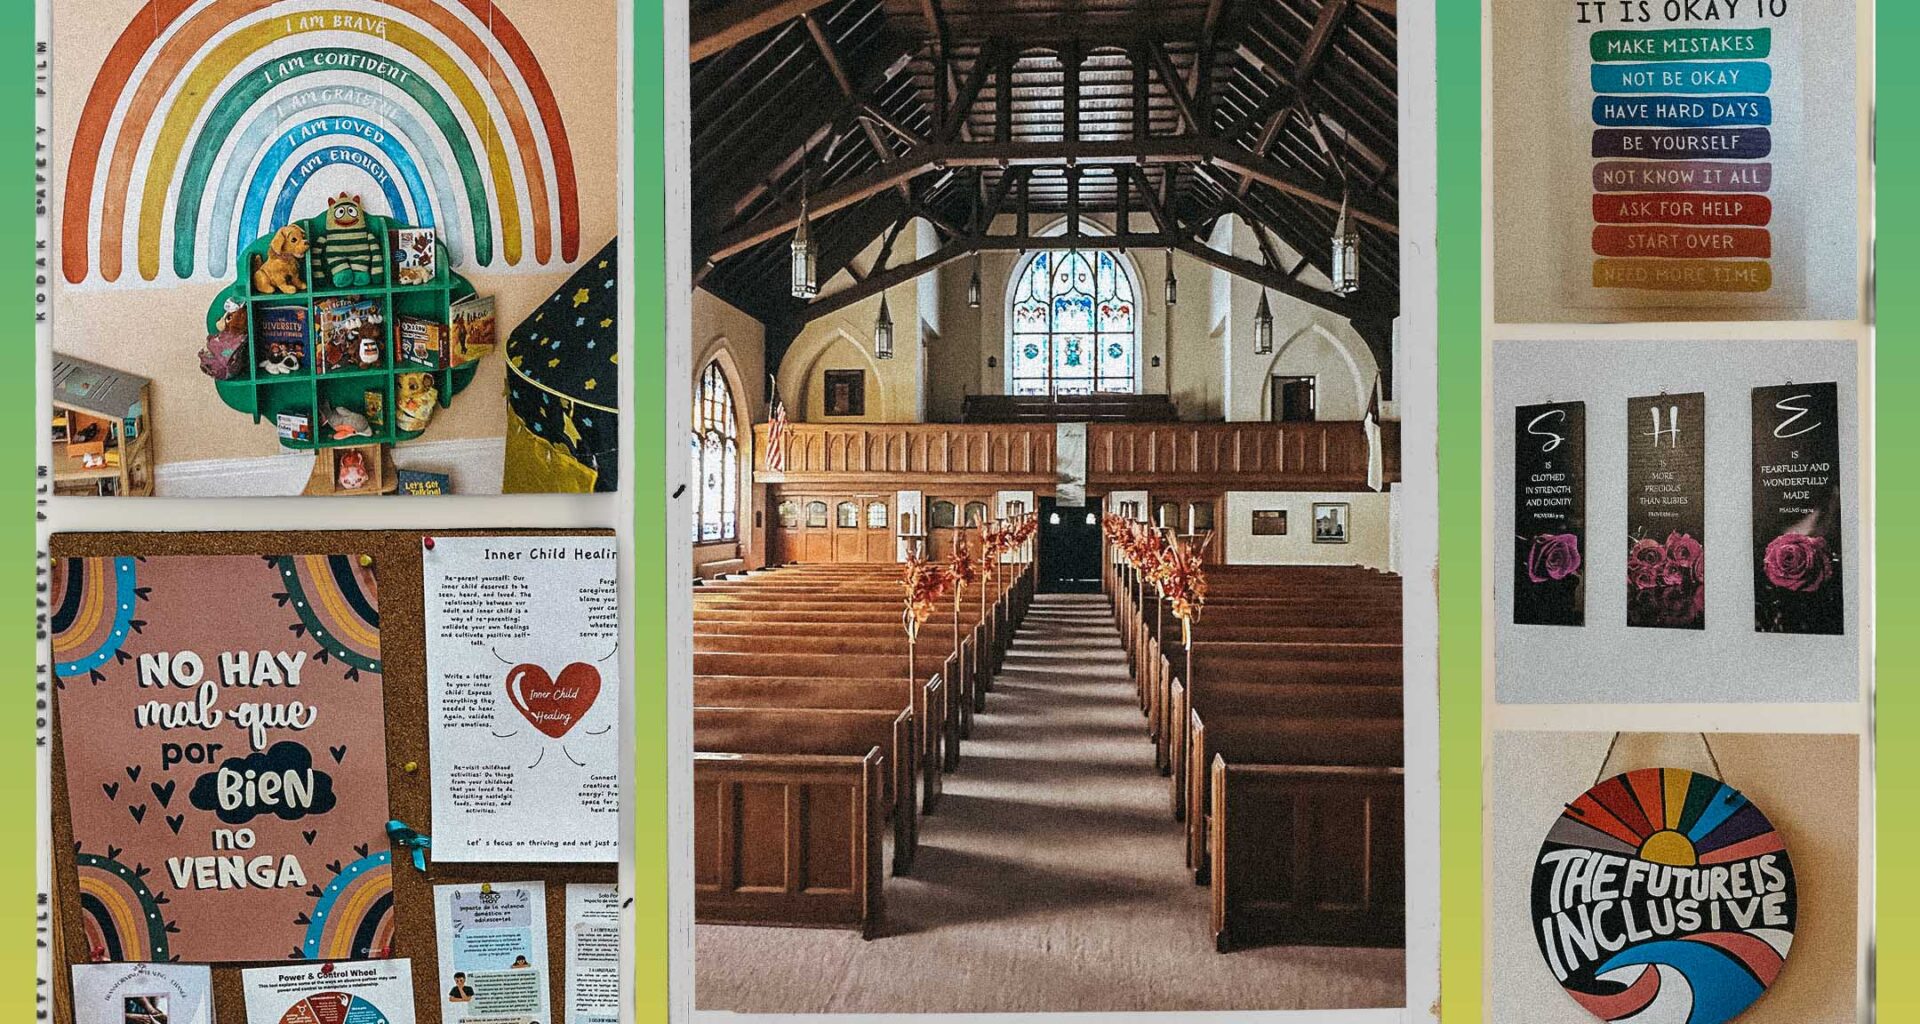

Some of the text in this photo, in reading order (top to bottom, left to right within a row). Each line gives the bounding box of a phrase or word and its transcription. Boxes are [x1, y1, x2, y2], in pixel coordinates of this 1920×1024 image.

[1578, 1, 1605, 24] IT
[1620, 1, 1651, 23] IS
[1664, 0, 1740, 22] OKAY
[287, 15, 387, 34] I AM BRAVE
[1608, 36, 1756, 54] MAKE MISTAKES
[264, 53, 410, 84] I AM CONFIDENT
[1622, 69, 1741, 87] NOT BE OKAY
[292, 91, 317, 106] AM
[1604, 102, 1759, 119] HAVE HARD DAYS
[287, 119, 385, 147] I AM LOVED
[1623, 135, 1741, 151] BE YOURSELF
[290, 150, 388, 187] I AM ENOUGH
[1603, 168, 1761, 184] NOT KNOW IT ALL
[1619, 201, 1743, 217] ASK FOR HELP
[1627, 234, 1734, 250] START OVER
[1604, 267, 1648, 283] NEED
[1712, 267, 1758, 283] TIME
[1774, 395, 1821, 438] E
[1528, 410, 1566, 452] S
[1643, 406, 1680, 448] H
[1792, 451, 1799, 459] IS
[1545, 461, 1552, 469] IS
[1761, 463, 1830, 473] FEARFULLY AND
[1532, 474, 1565, 482] CLOTHED
[1652, 472, 1673, 480] MORE
[1763, 477, 1829, 487] WONDERFULLY
[1535, 486, 1571, 494] STRENGTH
[1644, 485, 1681, 493] PRECIOUS
[1784, 491, 1810, 499] MADE
[1544, 498, 1572, 506] DIGNITY
[485, 548, 522, 560] Inner
[529, 548, 566, 560] Child
[138, 650, 307, 687] NO HAY
[529, 688, 578, 701] Inner Child
[135, 680, 317, 750] mal que
[532, 711, 573, 726] Healing
[162, 742, 223, 771] por
[213, 827, 256, 850] no
[529, 839, 559, 848] thriving
[165, 854, 307, 890] VENGA
[1541, 849, 1786, 914] THE FUTURE IS
[1542, 891, 1789, 982] INCLUSIVE
[278, 974, 305, 982] Power
[308, 972, 314, 980] &
[317, 970, 348, 979] Control
[350, 968, 376, 977] Wheel
